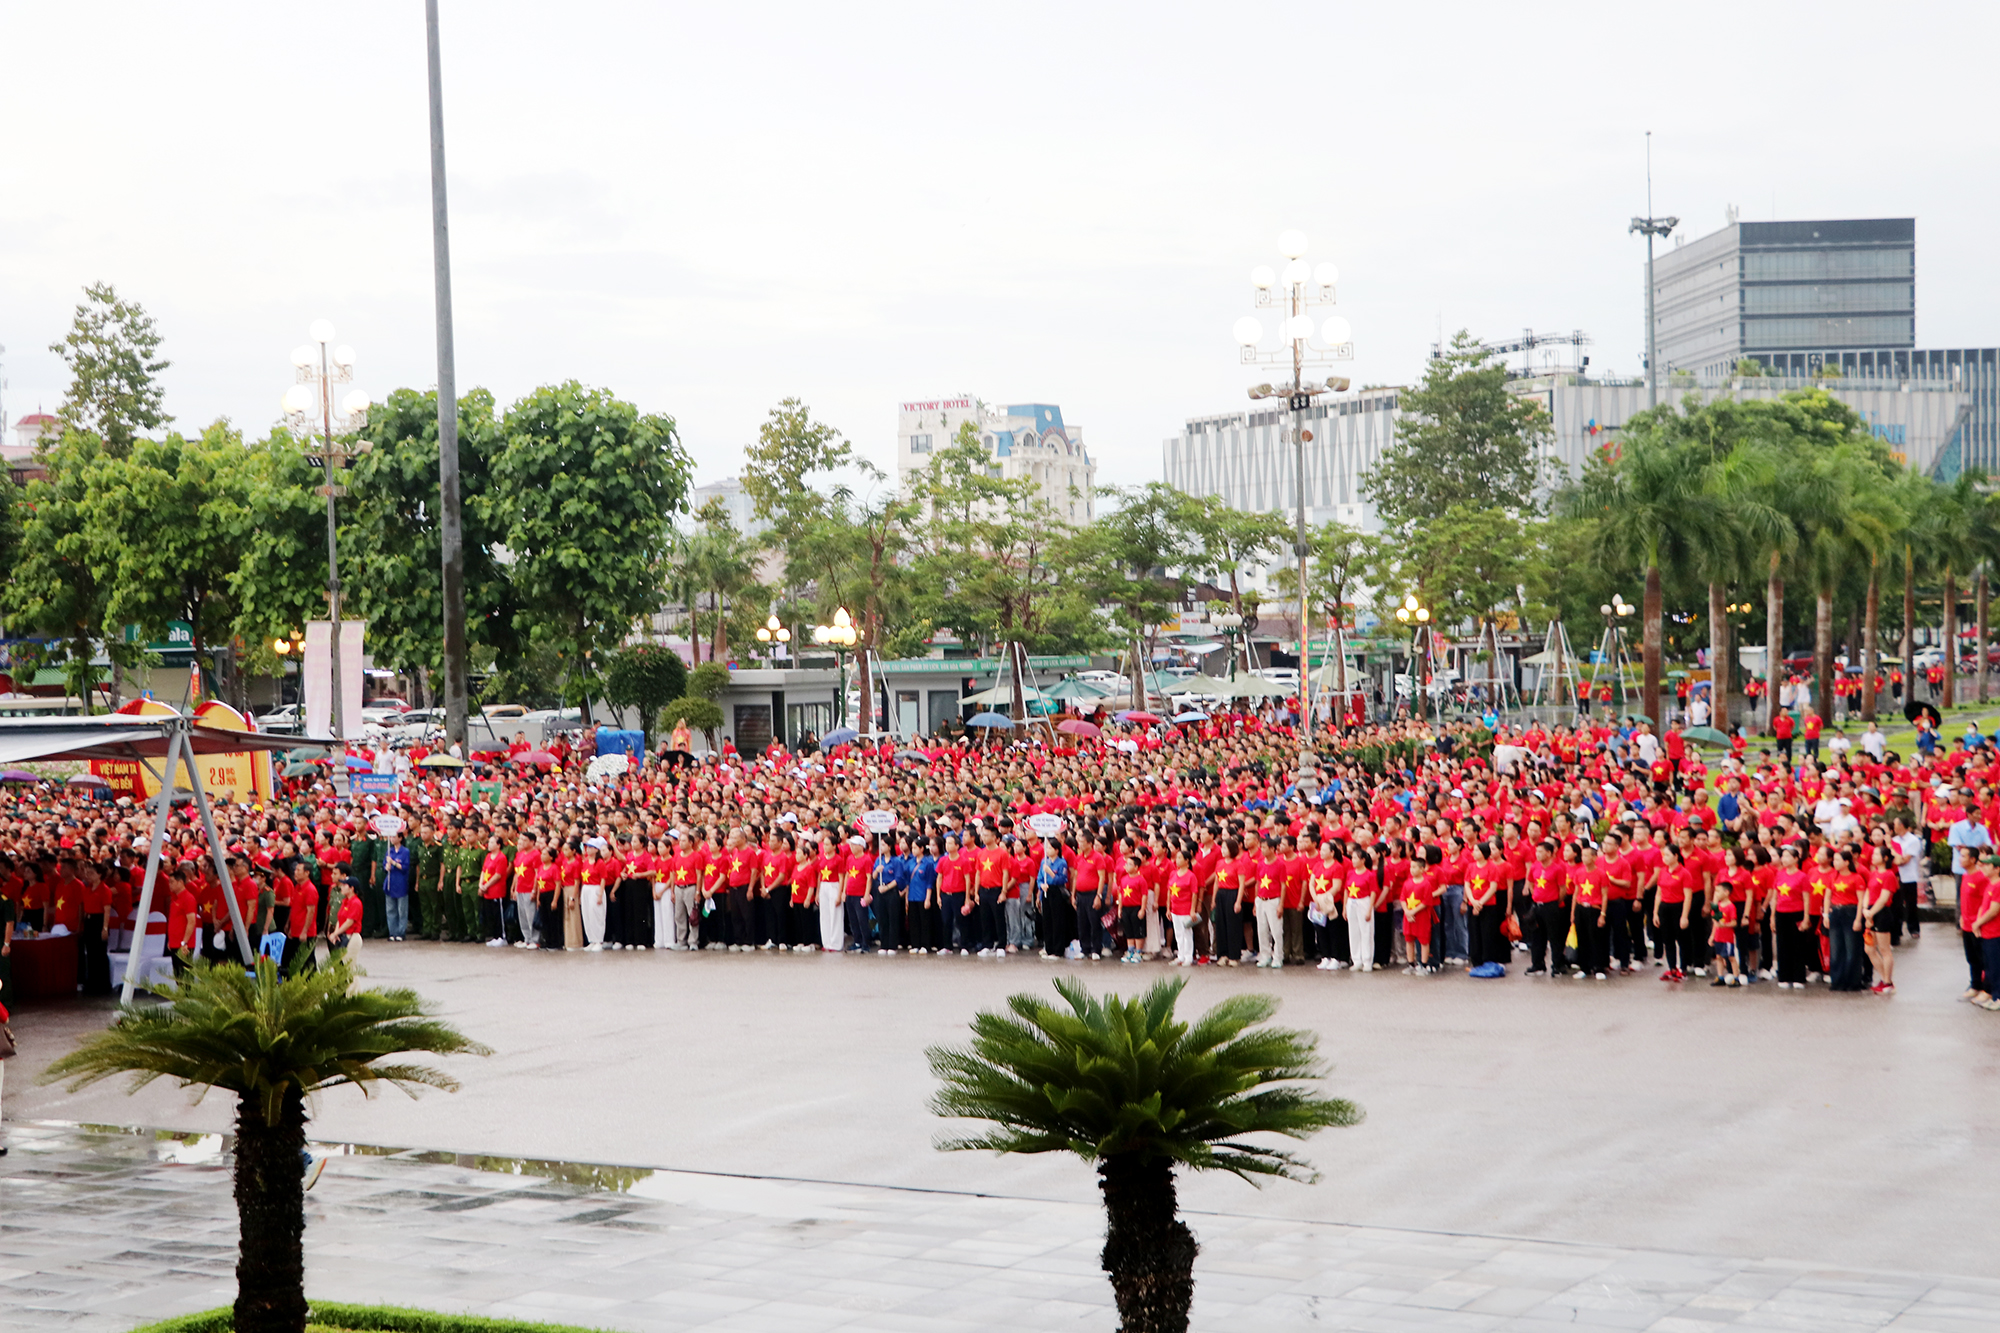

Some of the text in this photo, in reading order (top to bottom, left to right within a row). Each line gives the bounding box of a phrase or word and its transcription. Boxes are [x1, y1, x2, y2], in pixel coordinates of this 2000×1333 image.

[903, 399, 971, 411] VICTORY HOTEL
[1869, 424, 1906, 444] INH
[100, 762, 138, 776] VIỆT NAM TA
[209, 766, 225, 786] 2.9
